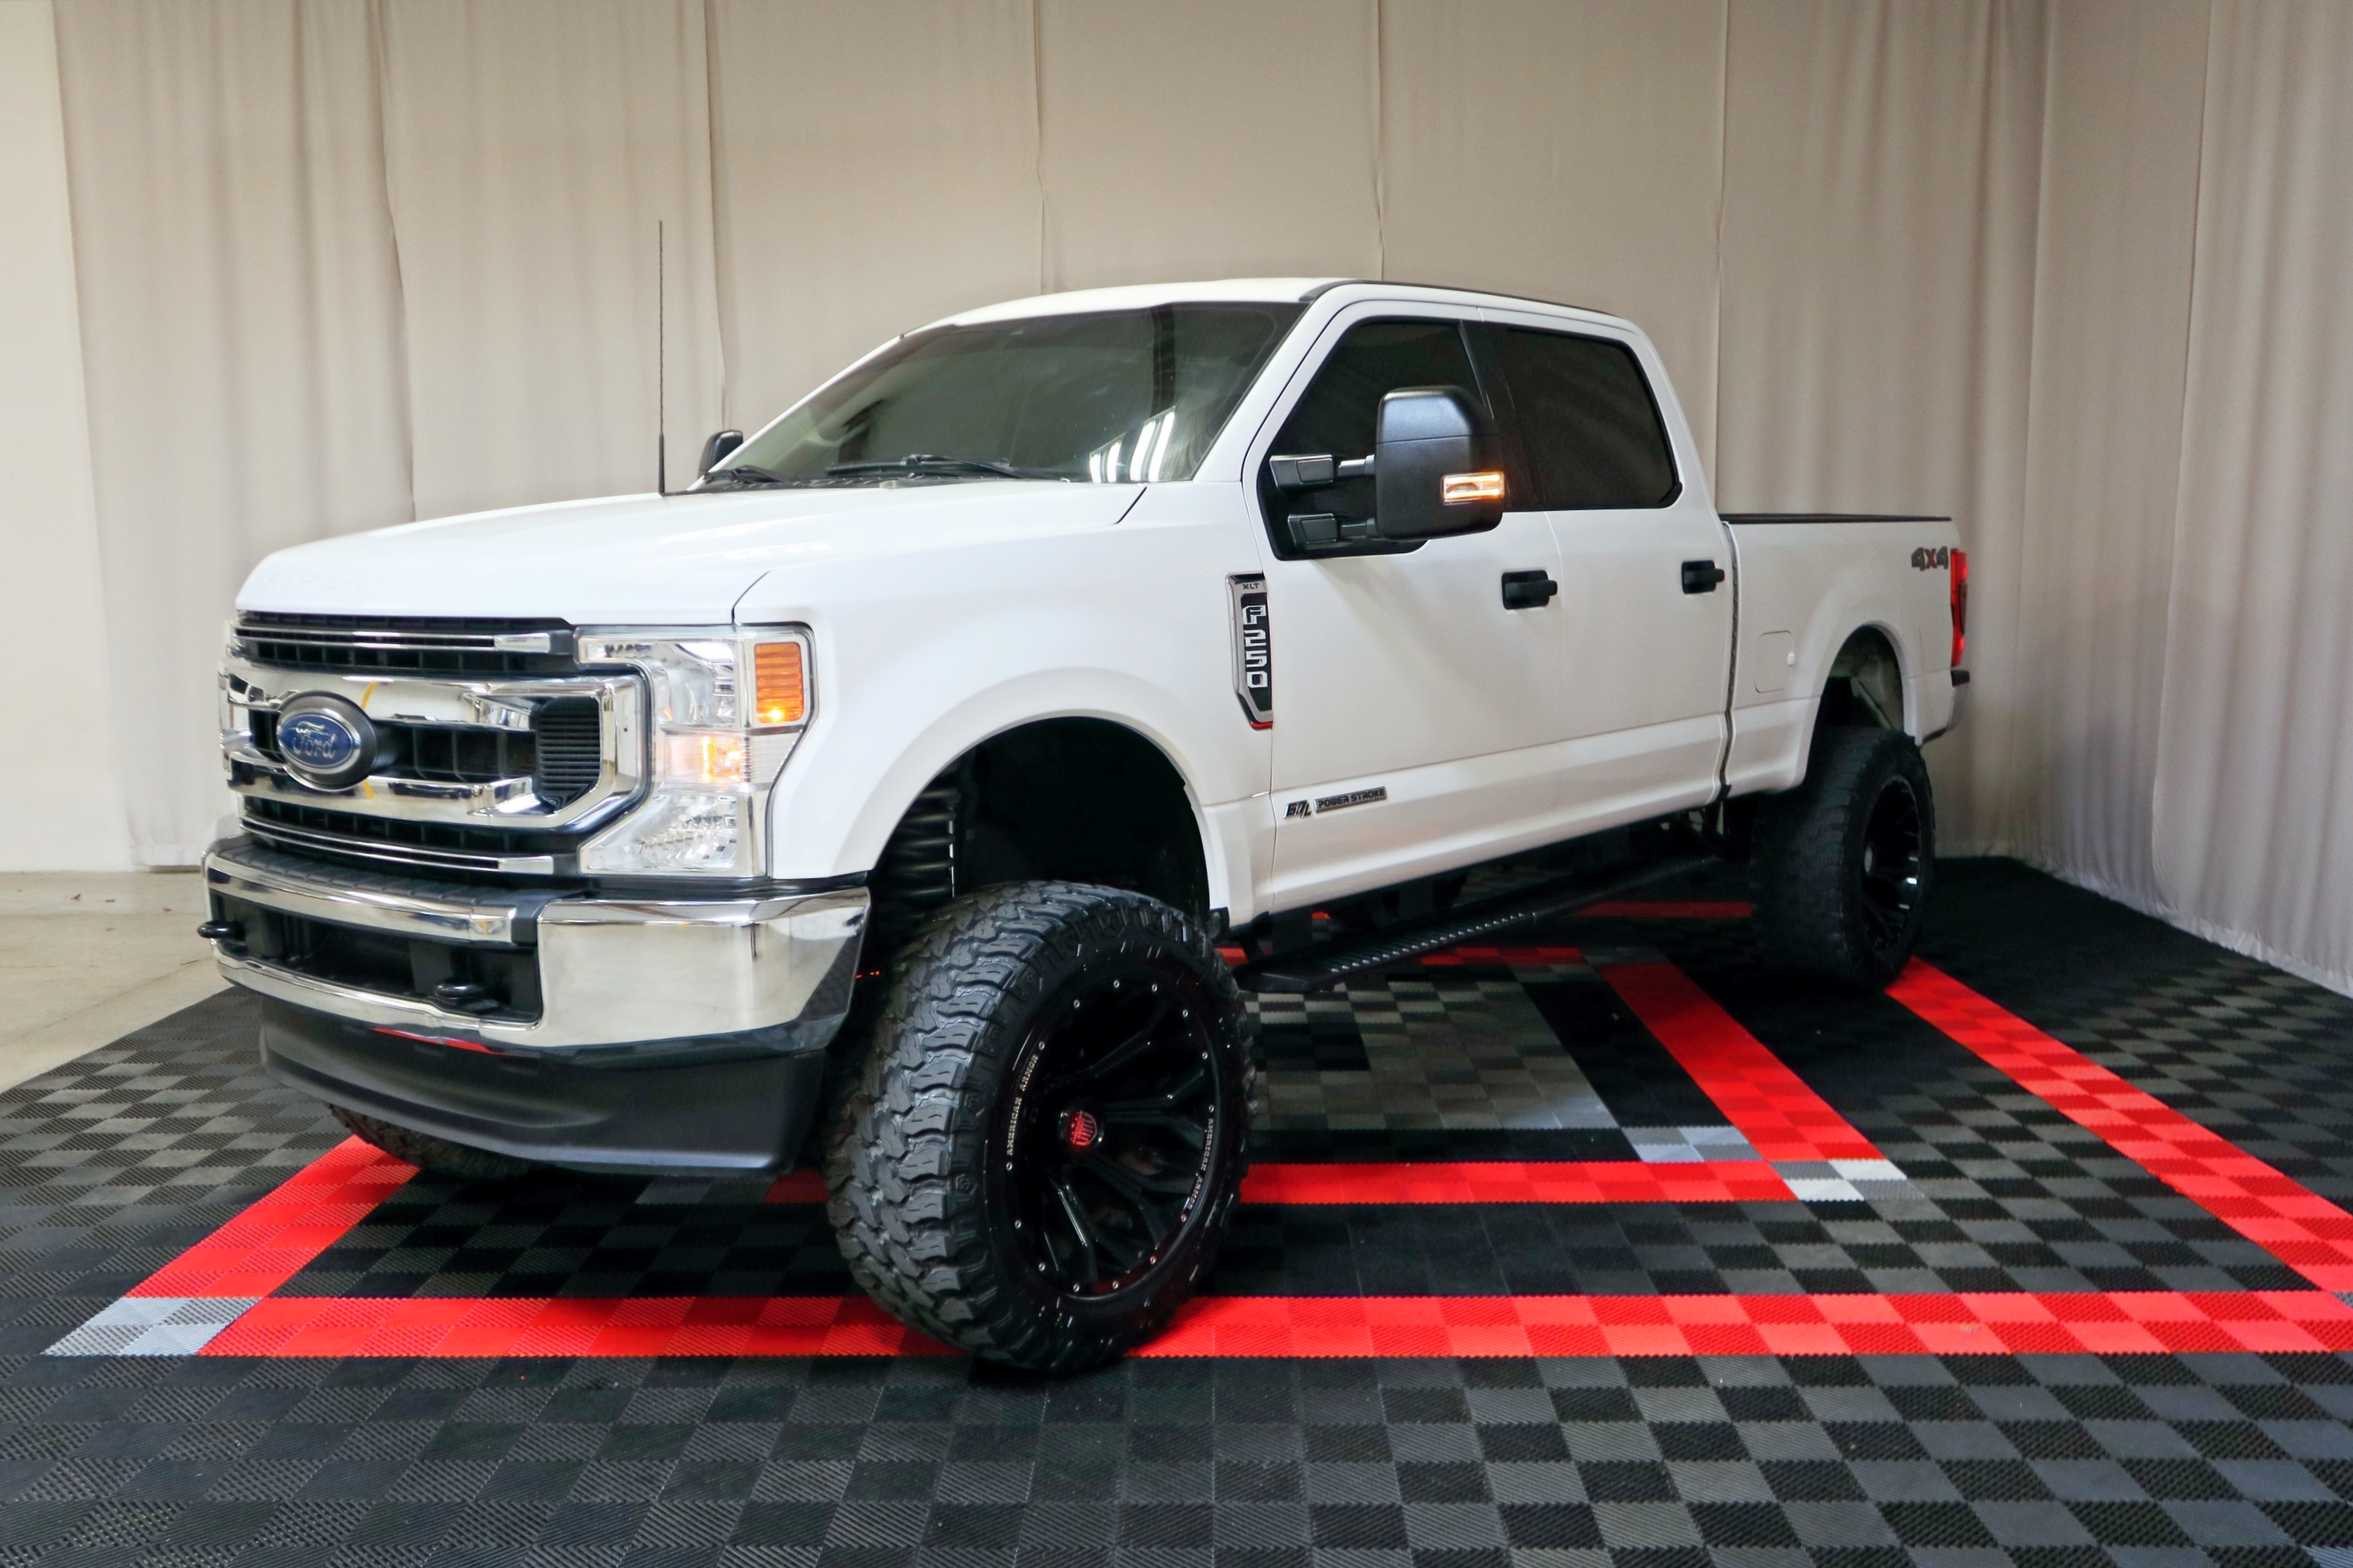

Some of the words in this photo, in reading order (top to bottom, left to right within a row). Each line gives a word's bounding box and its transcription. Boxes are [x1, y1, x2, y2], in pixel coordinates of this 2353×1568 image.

[1242, 605, 1268, 688] F250
[292, 721, 336, 759] Ford
[1319, 795, 1350, 808] POWER
[1350, 788, 1386, 802] STROKE
[1006, 1096, 1023, 1157] AMERICAN
[1019, 1054, 1039, 1093] ARMOR
